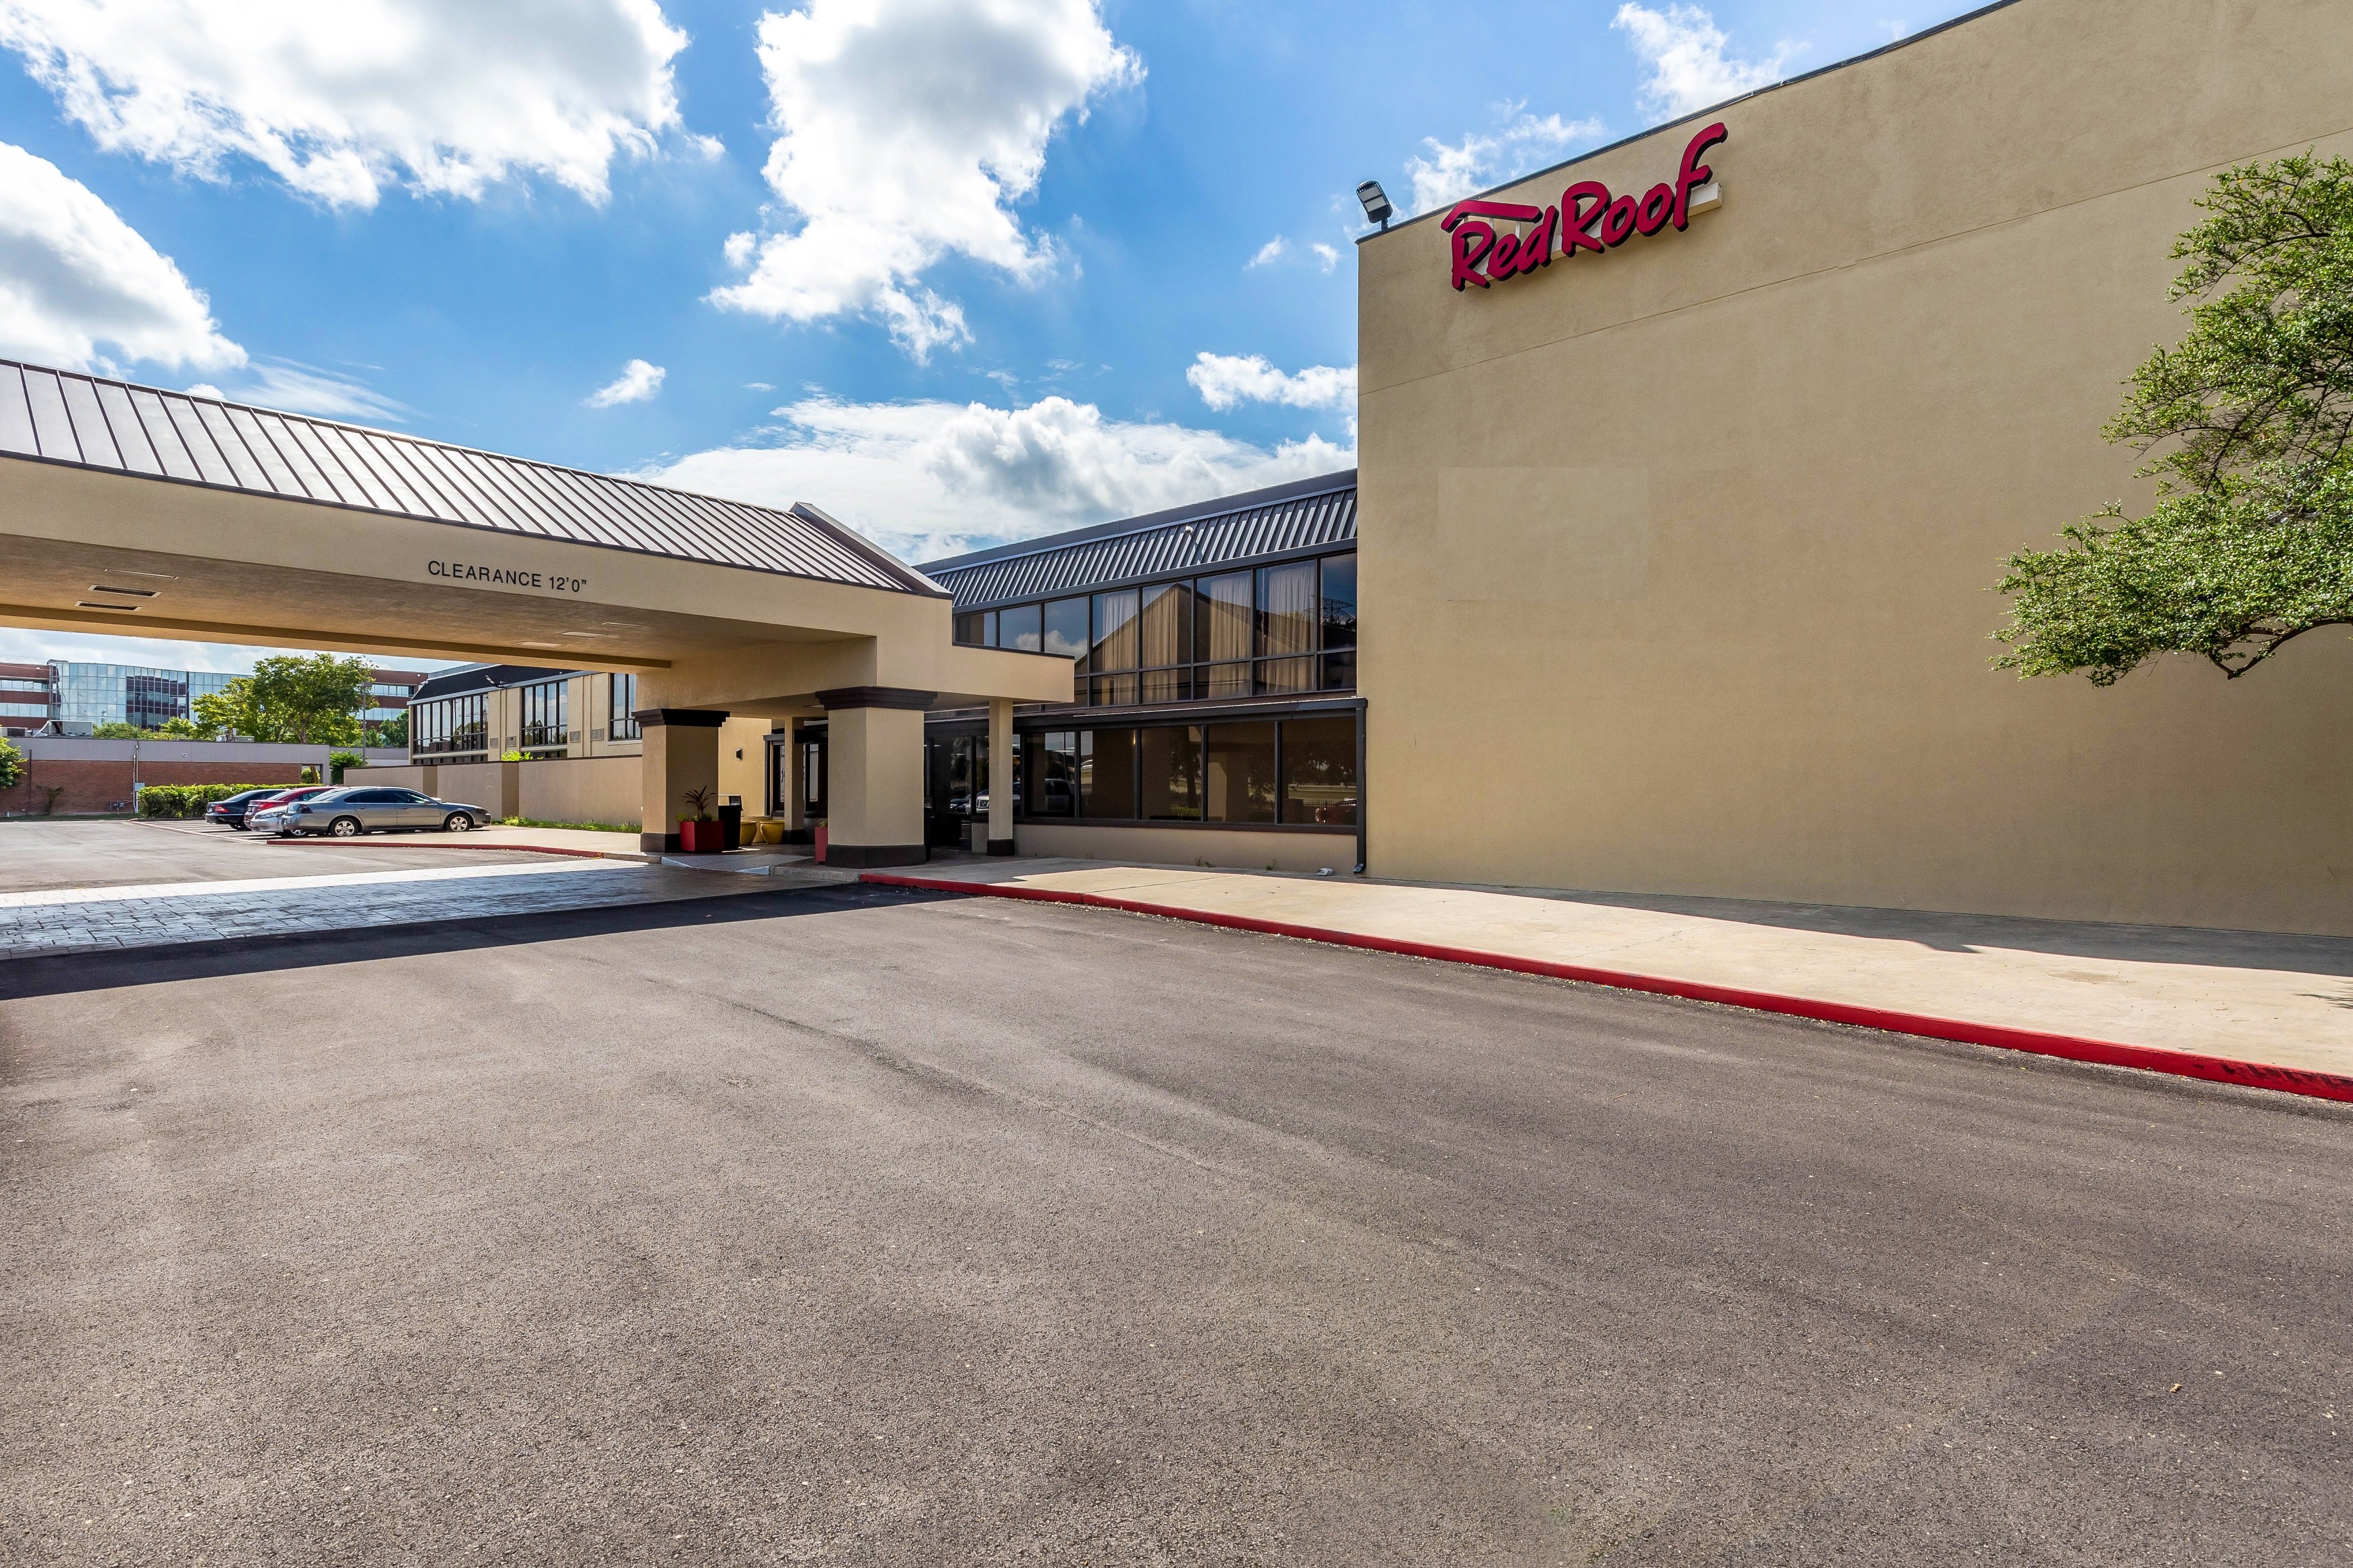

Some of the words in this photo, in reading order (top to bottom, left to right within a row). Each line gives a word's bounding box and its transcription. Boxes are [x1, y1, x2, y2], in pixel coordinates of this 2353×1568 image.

[1451, 205, 1560, 292] Red
[1561, 122, 1729, 258] Roof
[428, 560, 542, 588] CLEARANCE
